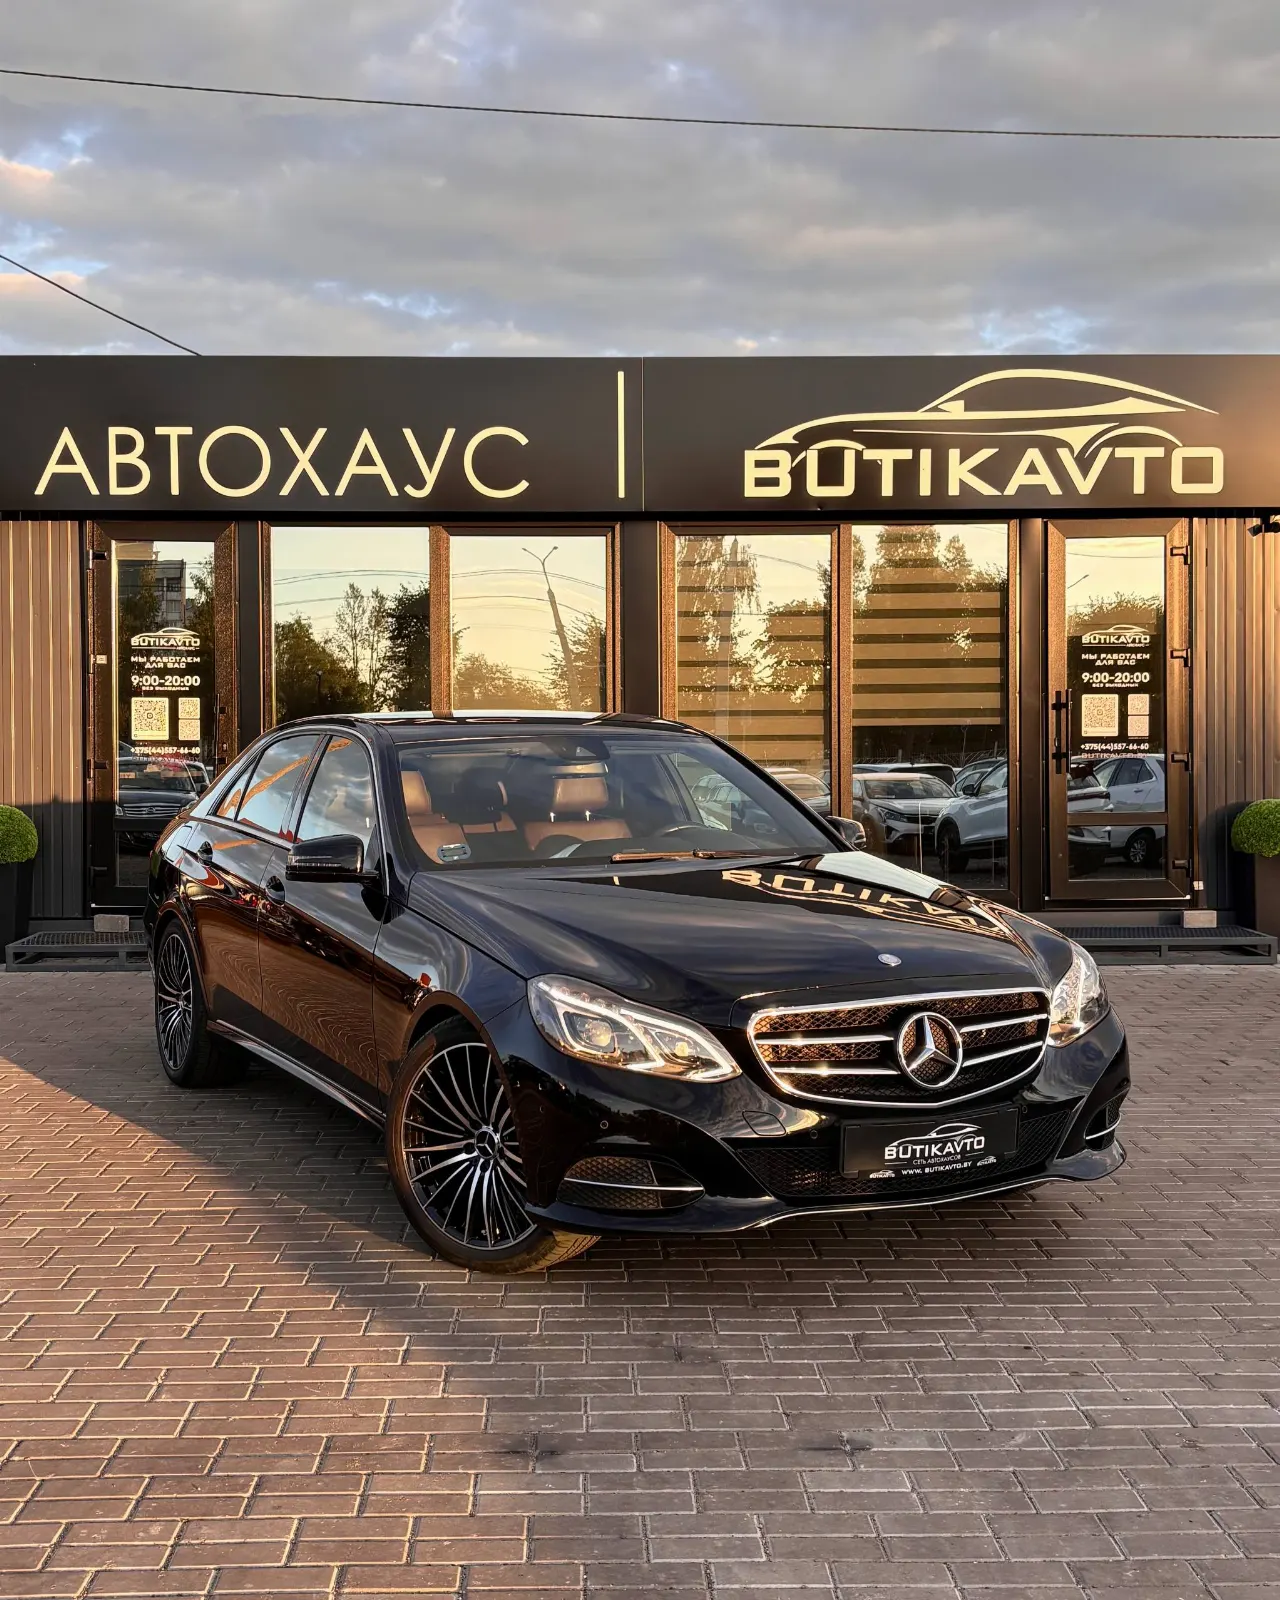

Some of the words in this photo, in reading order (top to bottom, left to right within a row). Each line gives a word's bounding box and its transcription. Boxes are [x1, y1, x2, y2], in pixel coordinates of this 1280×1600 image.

[34, 425, 529, 499] АВТОХАУС
[744, 446, 1225, 498] BUTIKAVTO
[131, 638, 200, 646] BUTIKAVTO
[1082, 635, 1150, 644] BUTIKAVTO
[131, 675, 201, 686] 9:00-20:00
[1081, 672, 1150, 683] 9:00-20:00
[130, 746, 201, 755] +375(44)557-66-60
[1080, 743, 1149, 751] +375(44)557-66-60
[884, 1136, 985, 1160] BUTIKAVTO
[924, 1160, 973, 1174] BUTIKAVTO.BY
